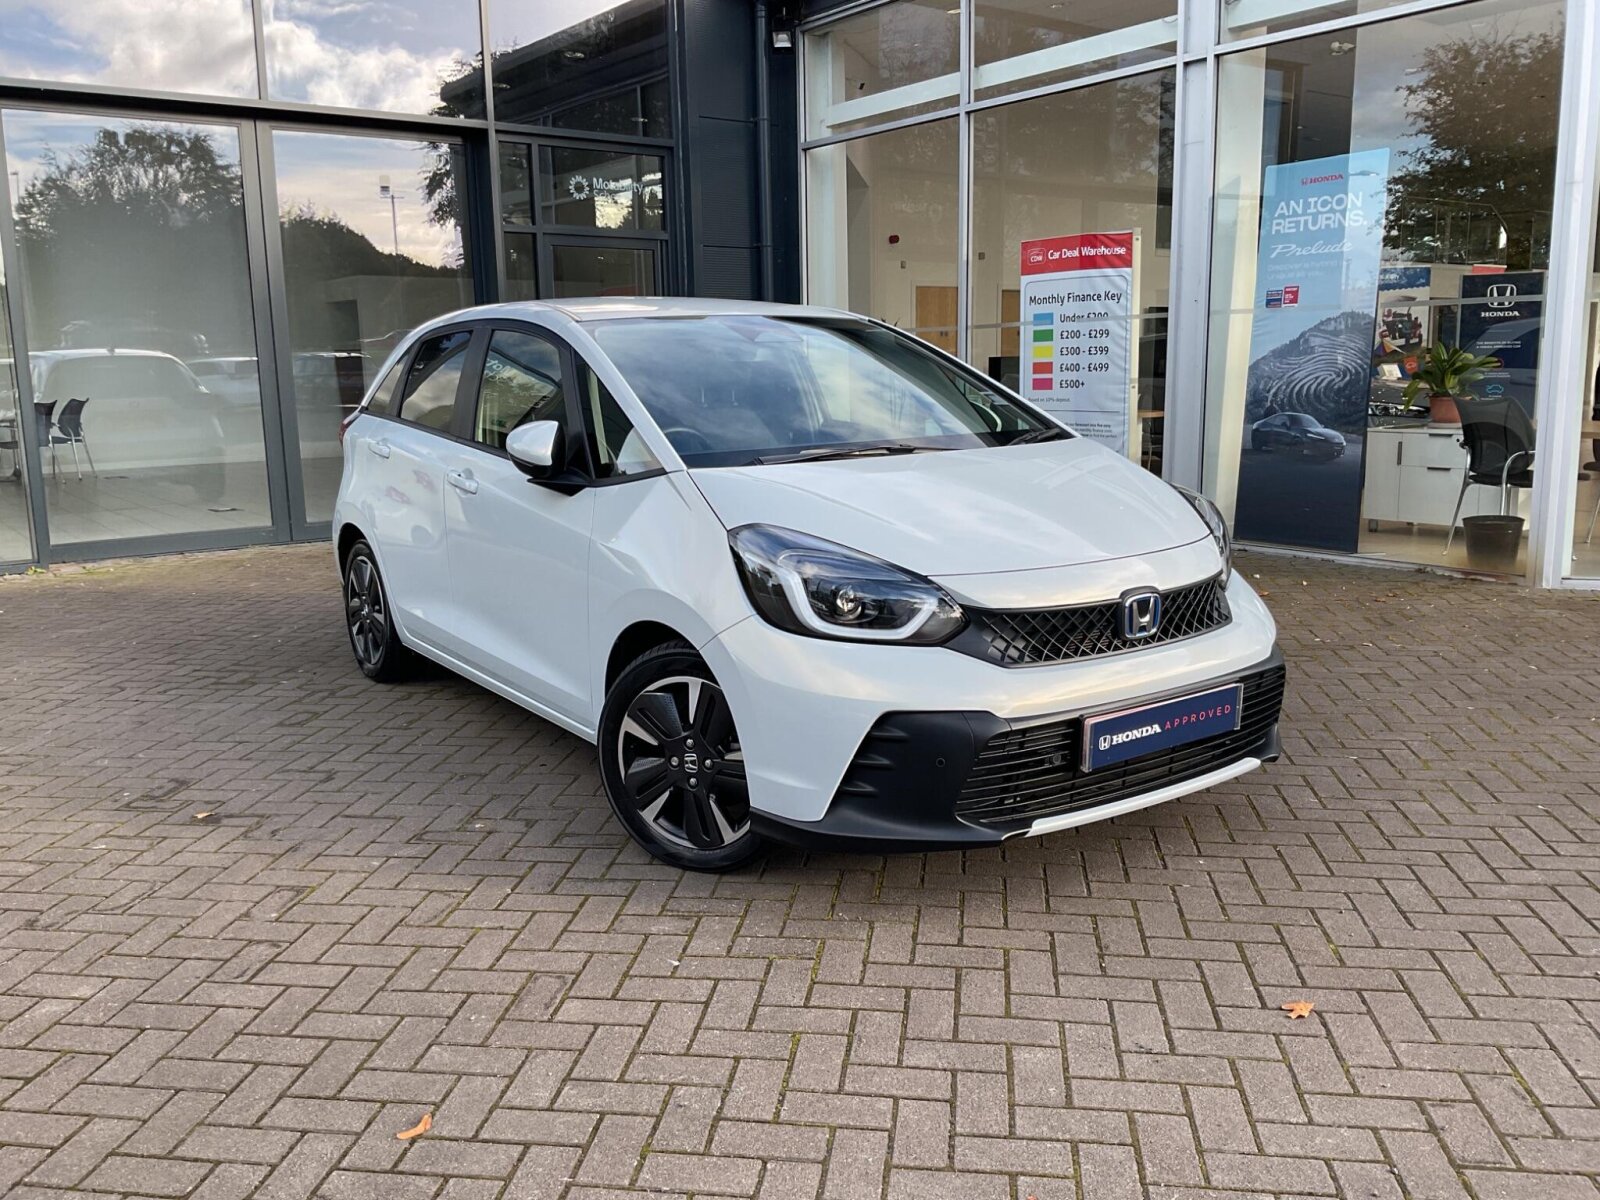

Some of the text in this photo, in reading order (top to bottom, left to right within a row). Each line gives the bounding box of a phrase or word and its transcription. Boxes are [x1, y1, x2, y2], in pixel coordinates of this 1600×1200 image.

[1309, 173, 1344, 184] HONDA
[1274, 191, 1363, 217] AN ICON
[1271, 209, 1368, 235] RETURNS.
[1048, 245, 1127, 260] Car Deal Warehouse
[1269, 240, 1353, 259] Prelude
[1029, 290, 1122, 306] Monthly Finance Key
[1480, 310, 1521, 318] HONDA
[1060, 330, 1081, 340] £200
[1088, 328, 1110, 339] £299
[1060, 346, 1081, 356] £300
[1088, 345, 1109, 356] £399
[1059, 363, 1081, 372] £400
[1088, 362, 1109, 372] £499
[1059, 379, 1085, 389] £500+
[1111, 723, 1162, 745] HONDA
[1164, 704, 1231, 731] APPROVED
